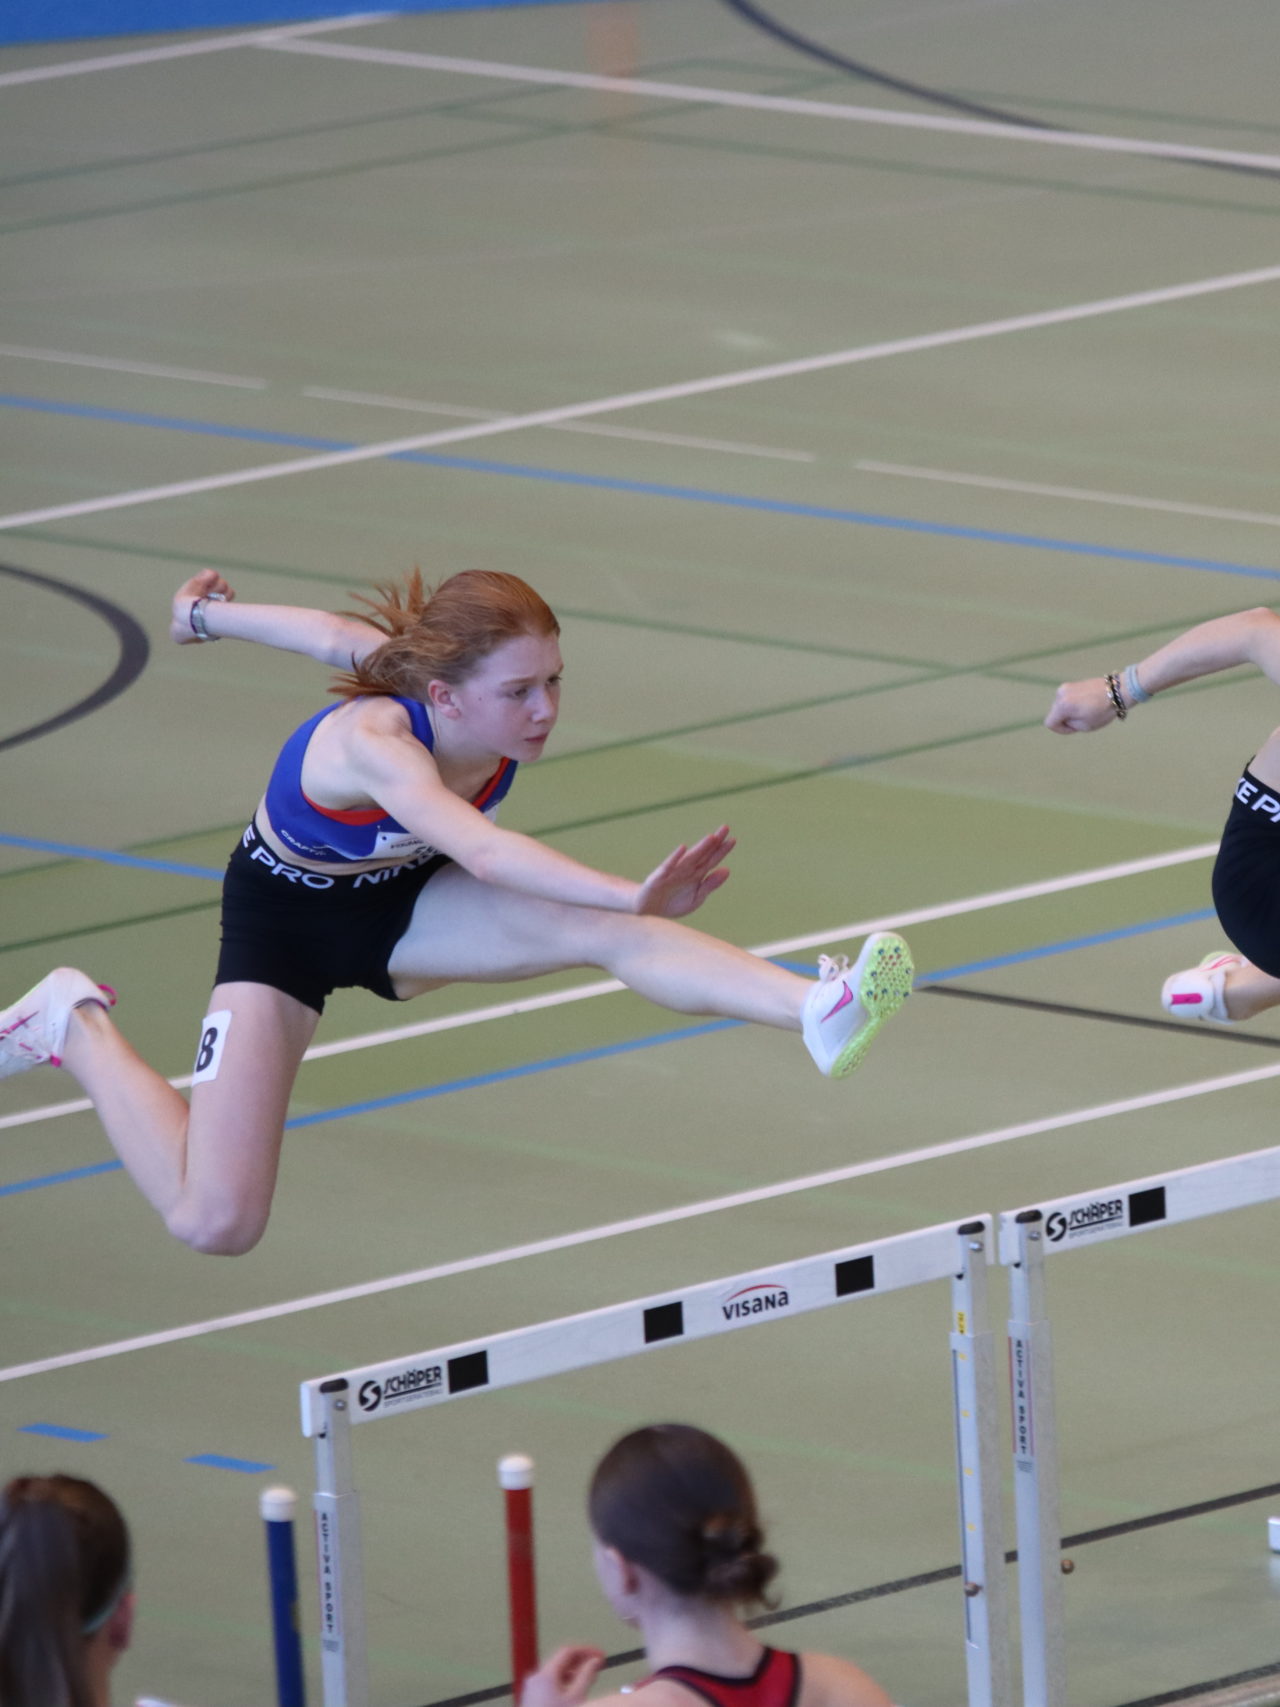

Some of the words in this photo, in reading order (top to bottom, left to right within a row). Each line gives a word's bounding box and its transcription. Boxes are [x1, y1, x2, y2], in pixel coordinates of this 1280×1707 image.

[250, 845, 335, 889] PRO
[196, 1027, 218, 1073] 8
[1068, 1199, 1123, 1227] SCHÄPER
[383, 1366, 442, 1395] SCHÄPER
[1016, 1339, 1025, 1399] ACTIVA
[1018, 1405, 1027, 1454] SPORT
[321, 1512, 331, 1575] ACTIVA
[324, 1581, 334, 1634] SPORT
